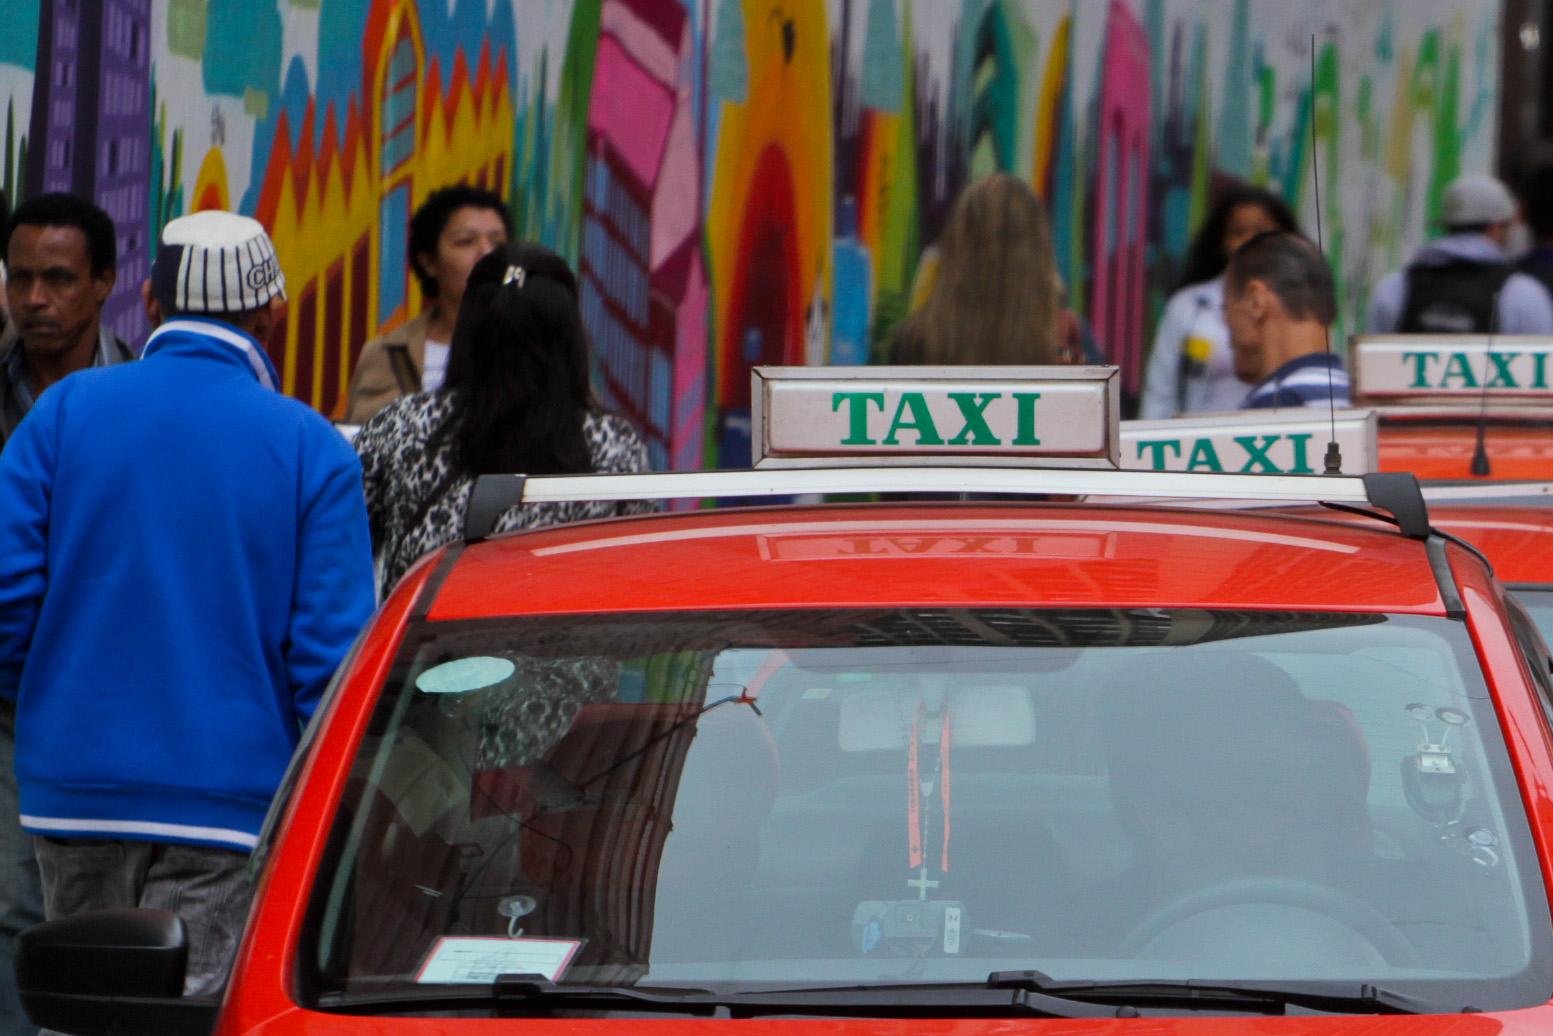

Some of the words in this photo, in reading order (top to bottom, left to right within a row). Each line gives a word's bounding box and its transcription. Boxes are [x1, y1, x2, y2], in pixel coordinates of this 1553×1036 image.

[1401, 351, 1550, 389] TAXI
[831, 391, 1041, 446] TAXI
[1136, 433, 1315, 475] TAXI
